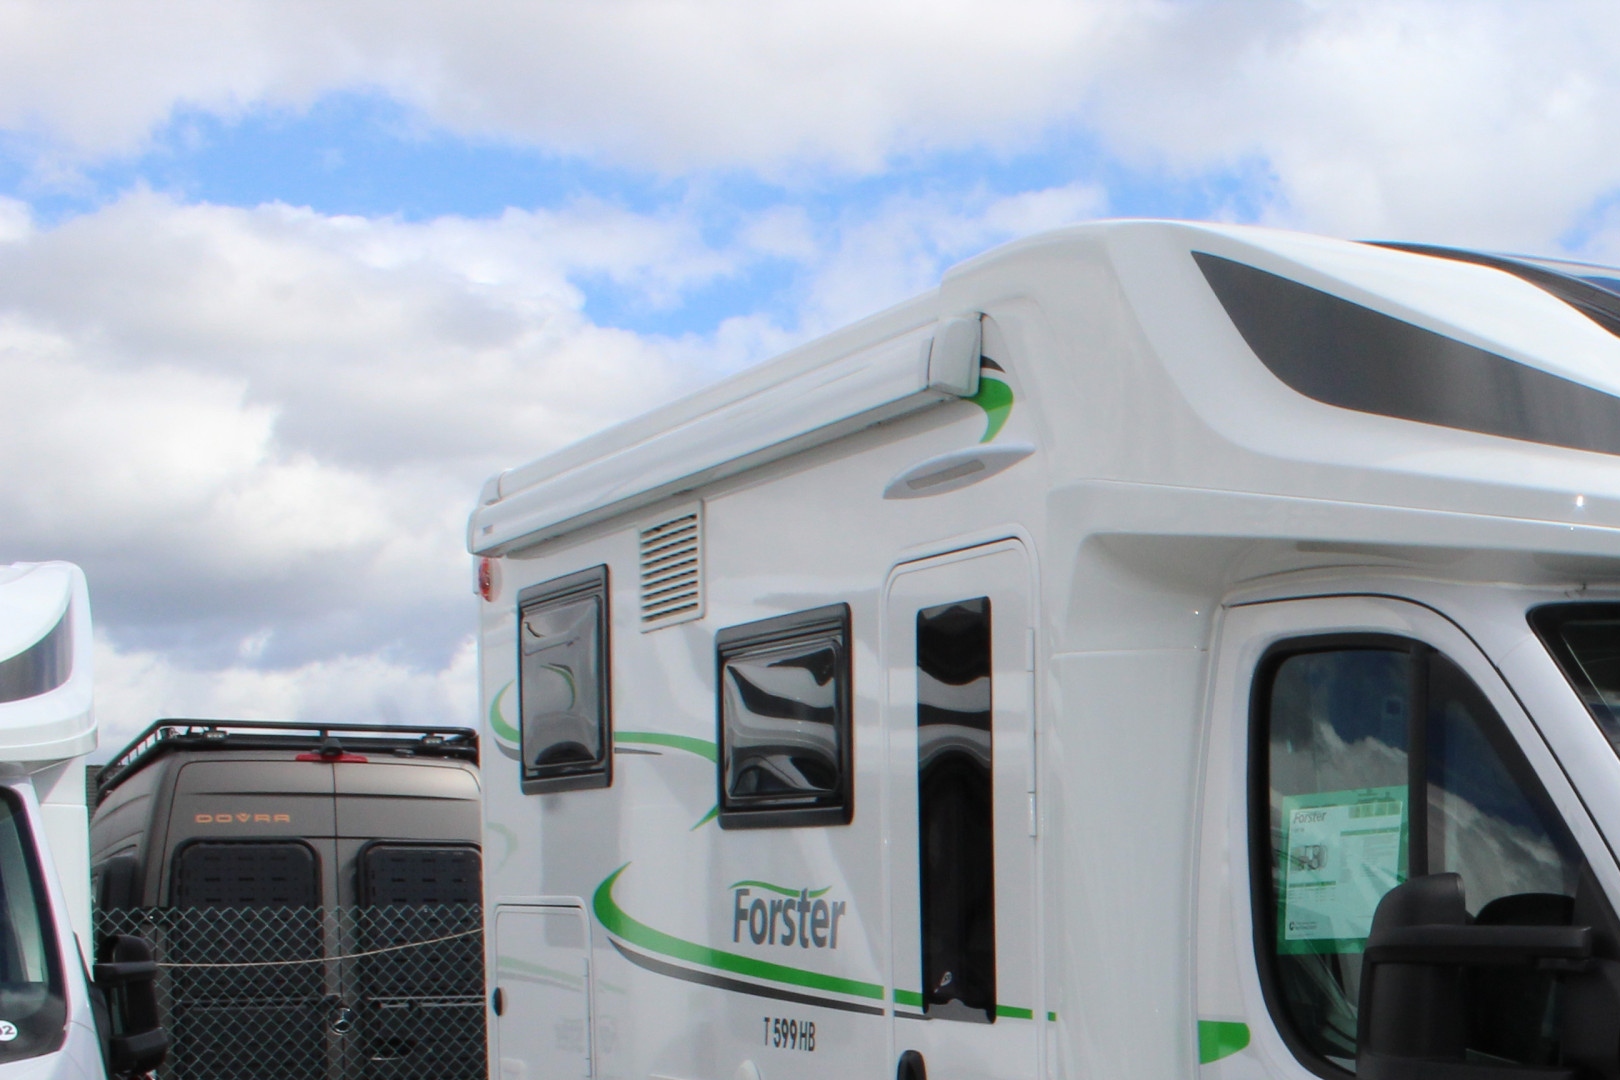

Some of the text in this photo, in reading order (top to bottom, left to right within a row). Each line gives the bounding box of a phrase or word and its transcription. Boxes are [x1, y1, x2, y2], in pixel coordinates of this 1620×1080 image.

[734, 888, 846, 948] Forster
[764, 1017, 816, 1052] T 599 HB
